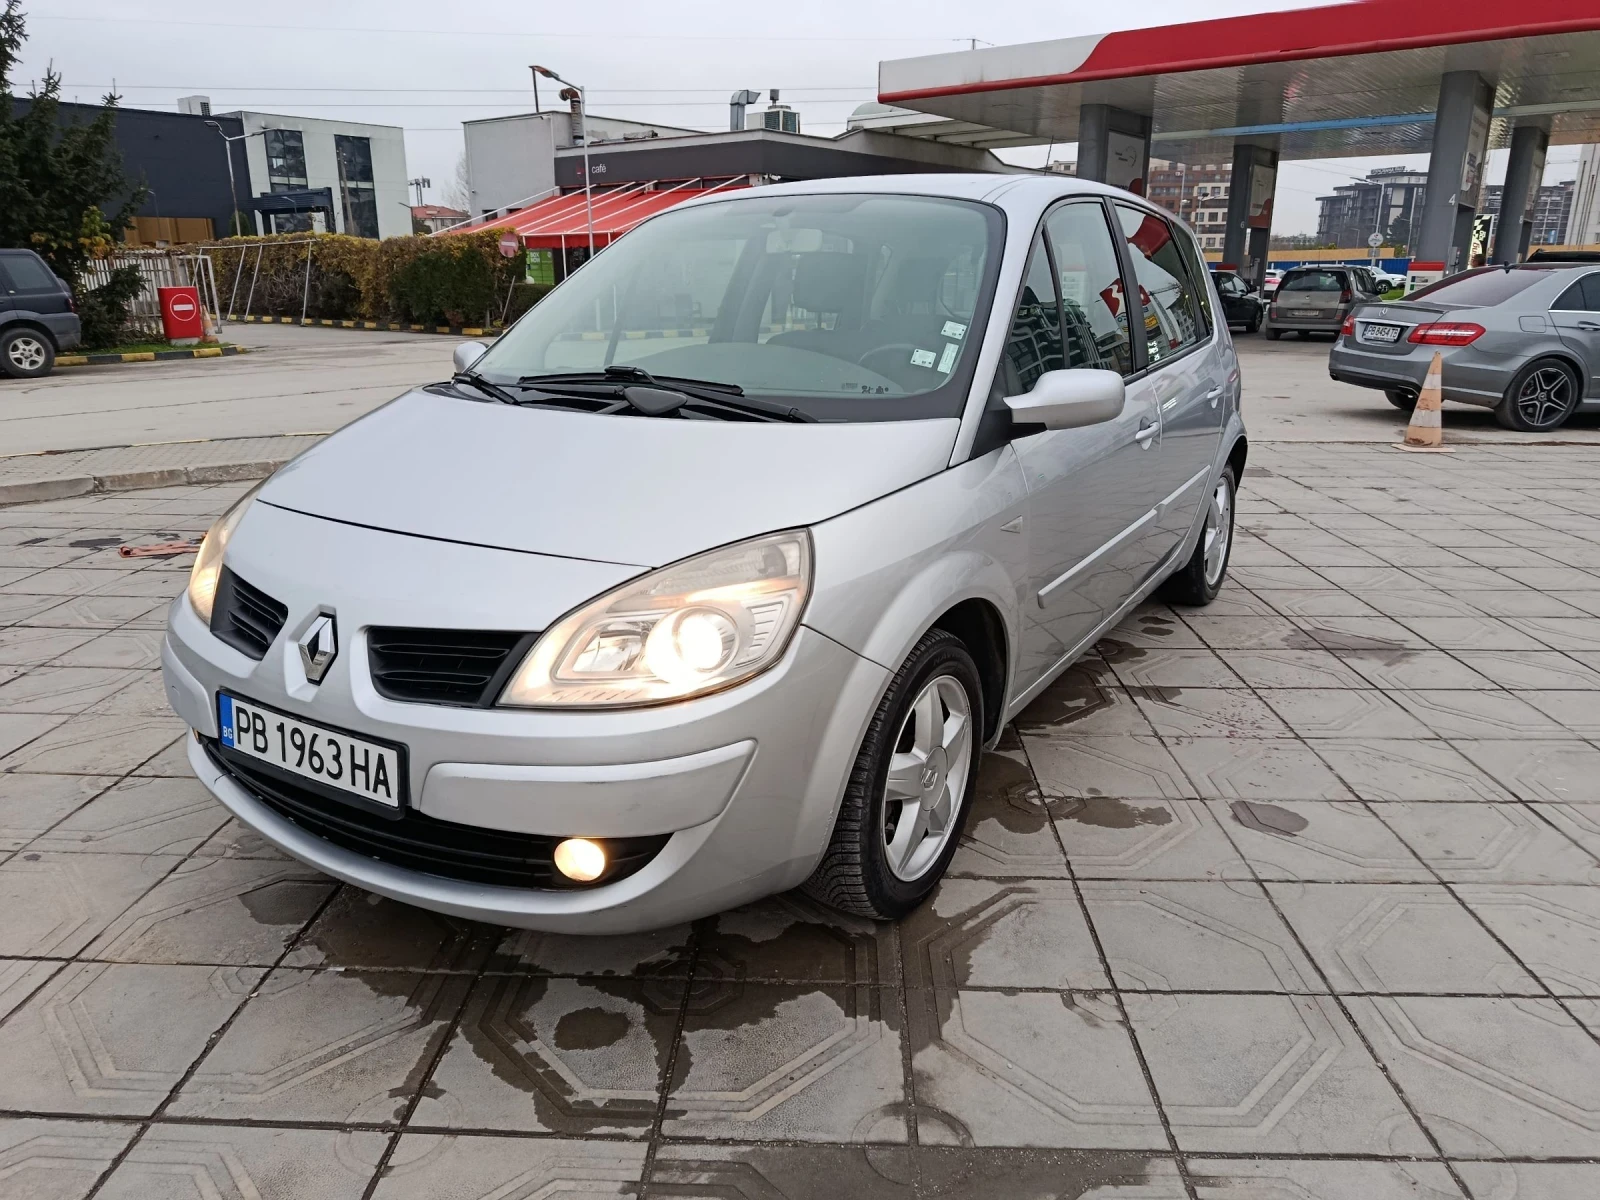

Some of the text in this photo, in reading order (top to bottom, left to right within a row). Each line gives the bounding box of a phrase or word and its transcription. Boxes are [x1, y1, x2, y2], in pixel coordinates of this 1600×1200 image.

[591, 163, 607, 174] café
[1448, 193, 1457, 205] 4
[1240, 220, 1245, 229] 6
[222, 725, 233, 740] BG
[235, 705, 392, 799] PB 1963 HA
